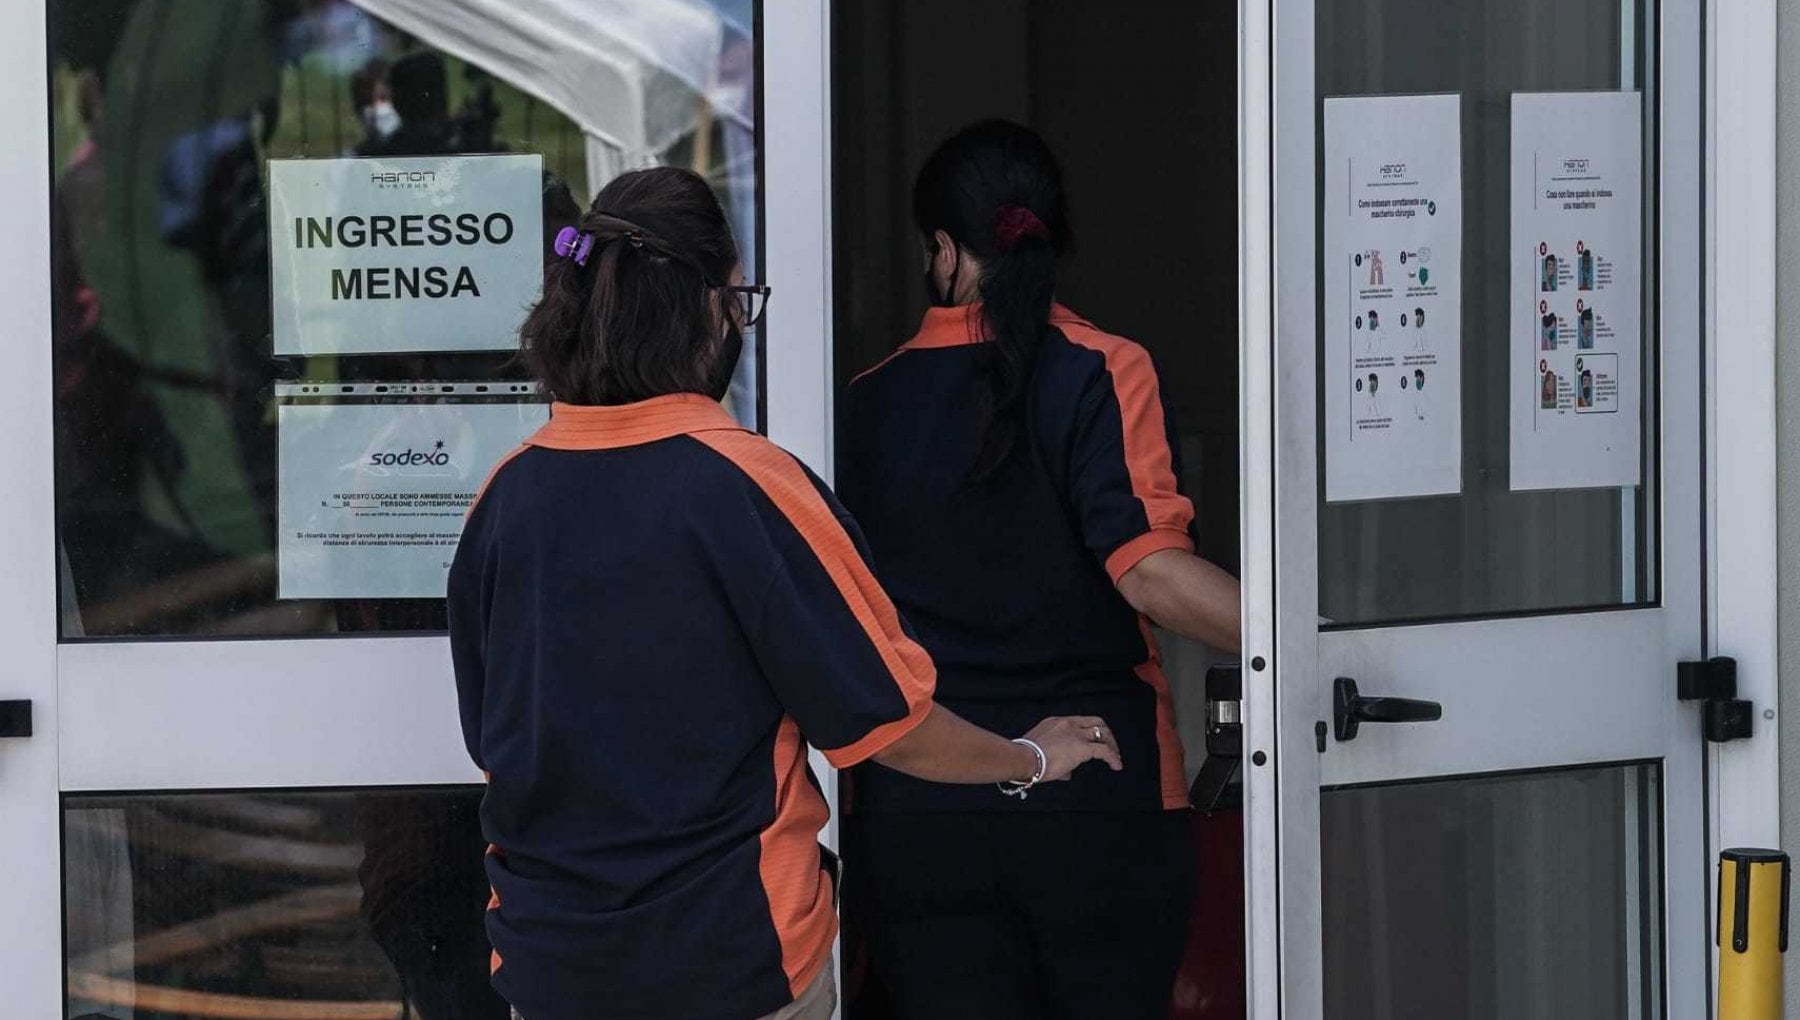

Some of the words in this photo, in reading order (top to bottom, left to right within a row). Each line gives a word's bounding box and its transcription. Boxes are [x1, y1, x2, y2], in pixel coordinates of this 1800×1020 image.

[295, 212, 515, 249] INGRESSO
[331, 266, 481, 300] MENSA
[369, 447, 450, 467] sodexo
[380, 500, 413, 508] PERSONE
[304, 531, 327, 539] ricorda
[328, 531, 340, 539] che
[341, 531, 356, 540] ogni
[395, 531, 428, 540] accogliere
[322, 539, 350, 547] distanza
[350, 539, 357, 547] di
[357, 539, 388, 547] sicurezza
[388, 539, 433, 548] interpersonale
